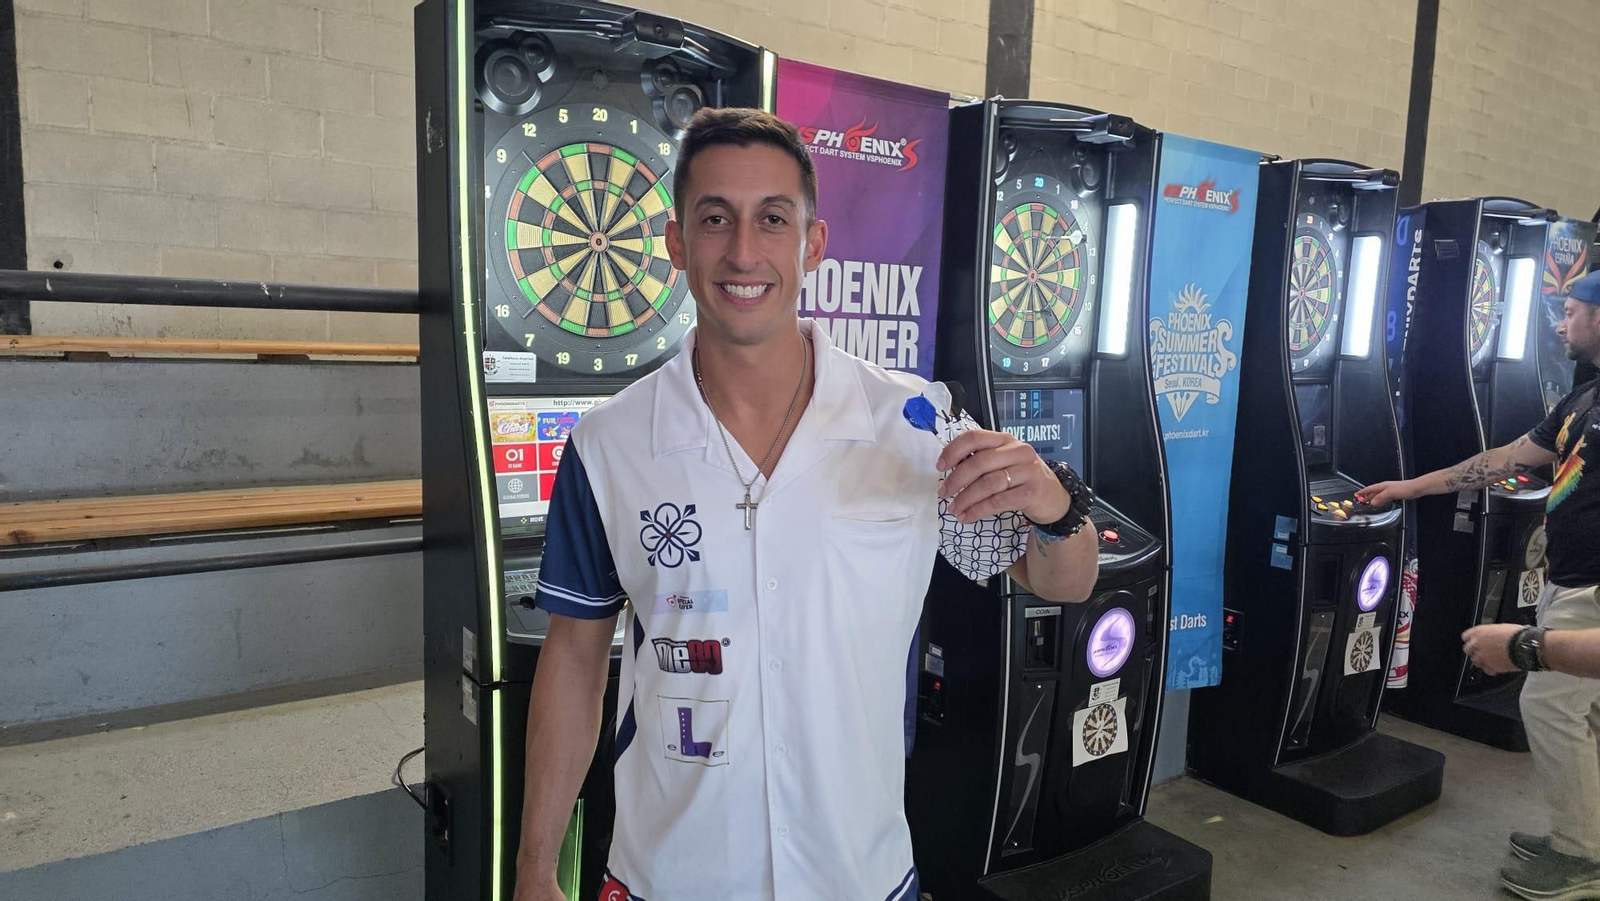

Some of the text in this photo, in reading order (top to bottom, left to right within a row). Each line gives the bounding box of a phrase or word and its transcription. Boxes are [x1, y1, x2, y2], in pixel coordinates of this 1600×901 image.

[558, 109, 569, 123] 5
[592, 108, 608, 122] 20
[521, 123, 537, 137] 12
[629, 120, 638, 134] 1
[496, 149, 507, 163] 9
[658, 143, 671, 156] 18
[819, 146, 838, 157] DART
[839, 150, 866, 161] SYSTEM
[866, 154, 902, 167] VSPHOENIX
[1016, 179, 1023, 190] 5
[1034, 177, 1044, 188] 20
[996, 190, 1004, 202] 12
[1055, 184, 1061, 195] 1
[1070, 200, 1079, 210] 18
[1083, 222, 1089, 232] 4
[1088, 249, 1096, 258] 13
[1090, 274, 1096, 285] 6
[798, 258, 923, 317] HOENIX
[495, 304, 510, 318] 16
[1084, 301, 1092, 312] 10
[678, 313, 690, 325] 15
[1168, 312, 1212, 331] PHOENIX
[524, 333, 535, 347] 7
[657, 337, 666, 350] 2
[815, 317, 919, 369] MMER
[1157, 328, 1217, 353] SUMMER
[1060, 344, 1066, 355] 2
[556, 352, 571, 365] 19
[593, 358, 603, 371] 3
[625, 354, 638, 366] 17
[1002, 357, 1011, 368] 19
[1041, 357, 1050, 367] 17
[1023, 361, 1029, 372] 3
[1020, 392, 1027, 400] 20
[1027, 424, 1060, 442] DARTS!
[505, 448, 524, 462] 01
[1180, 613, 1207, 630] Darts
[677, 707, 712, 759] L
